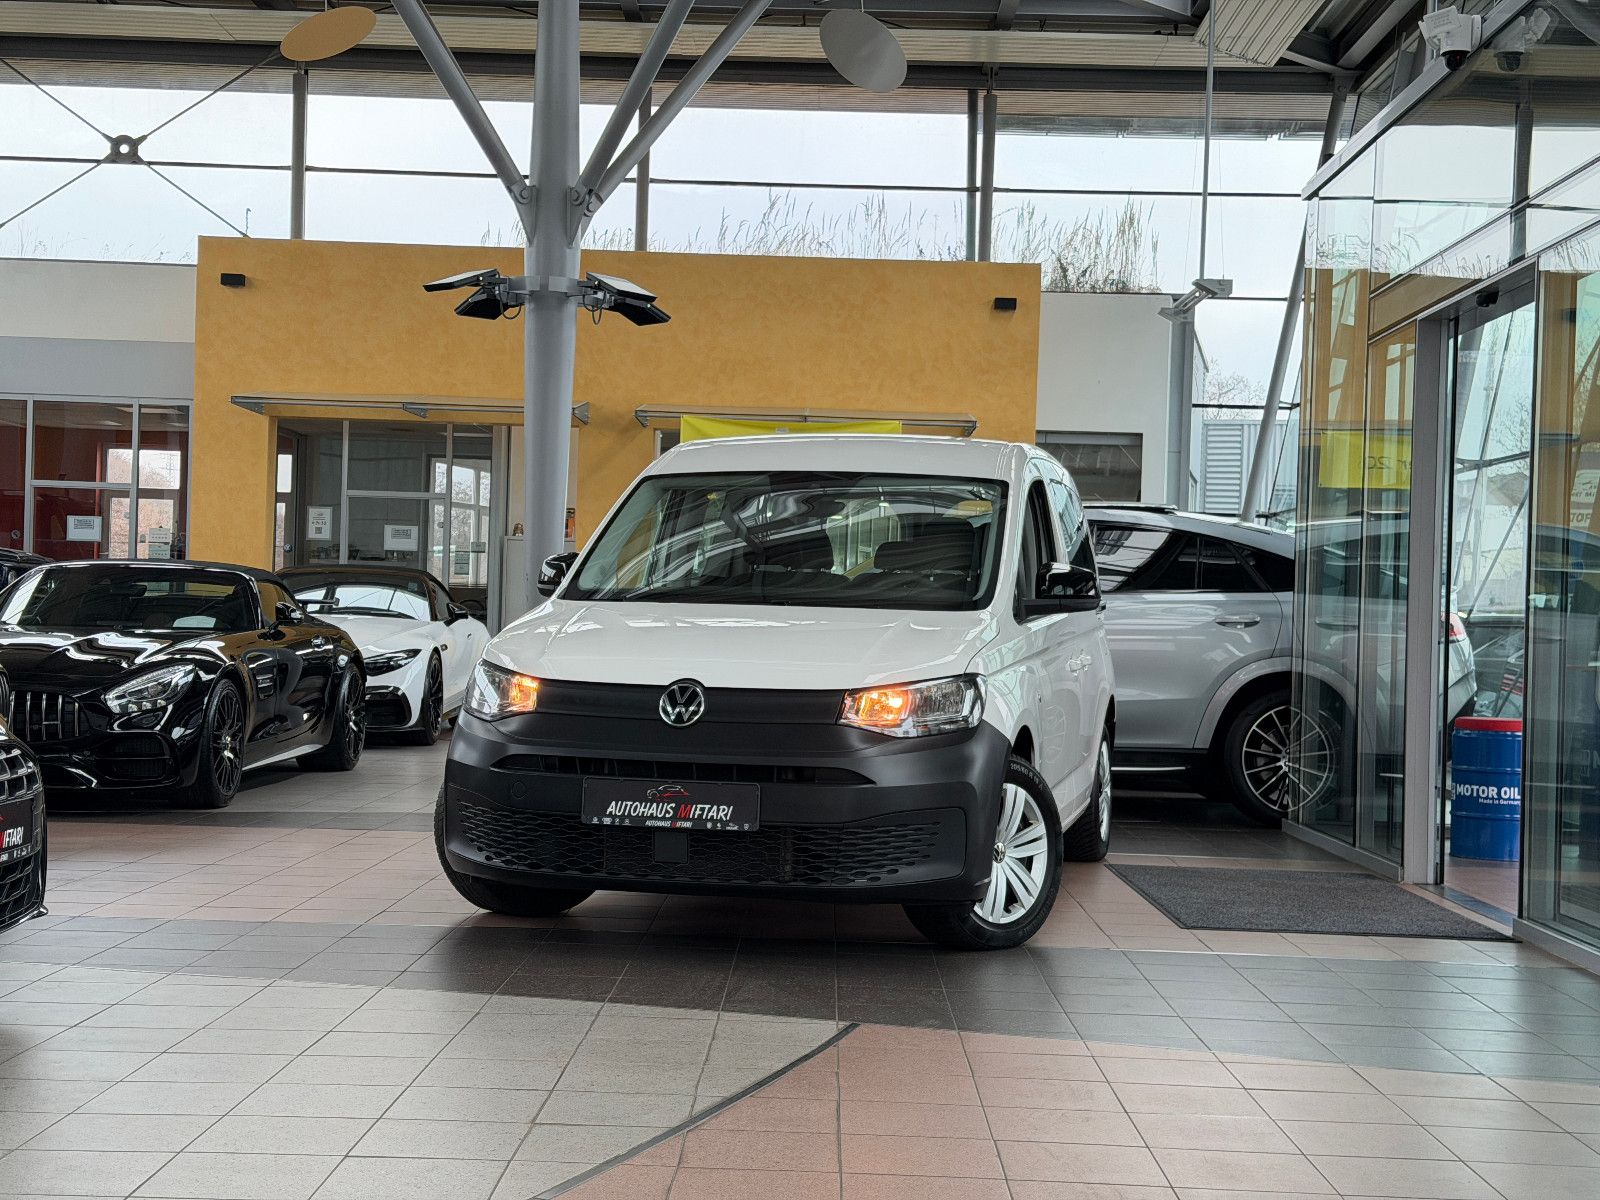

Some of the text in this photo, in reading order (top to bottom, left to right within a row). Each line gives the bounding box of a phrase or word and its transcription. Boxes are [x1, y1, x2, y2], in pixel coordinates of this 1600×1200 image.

[1456, 784, 1498, 799] MOTOR
[1500, 786, 1521, 800] OIL
[606, 800, 734, 822] AUTOHAUS MIFTARI
[645, 820, 693, 829] AUTOHAUS MIFTARI
